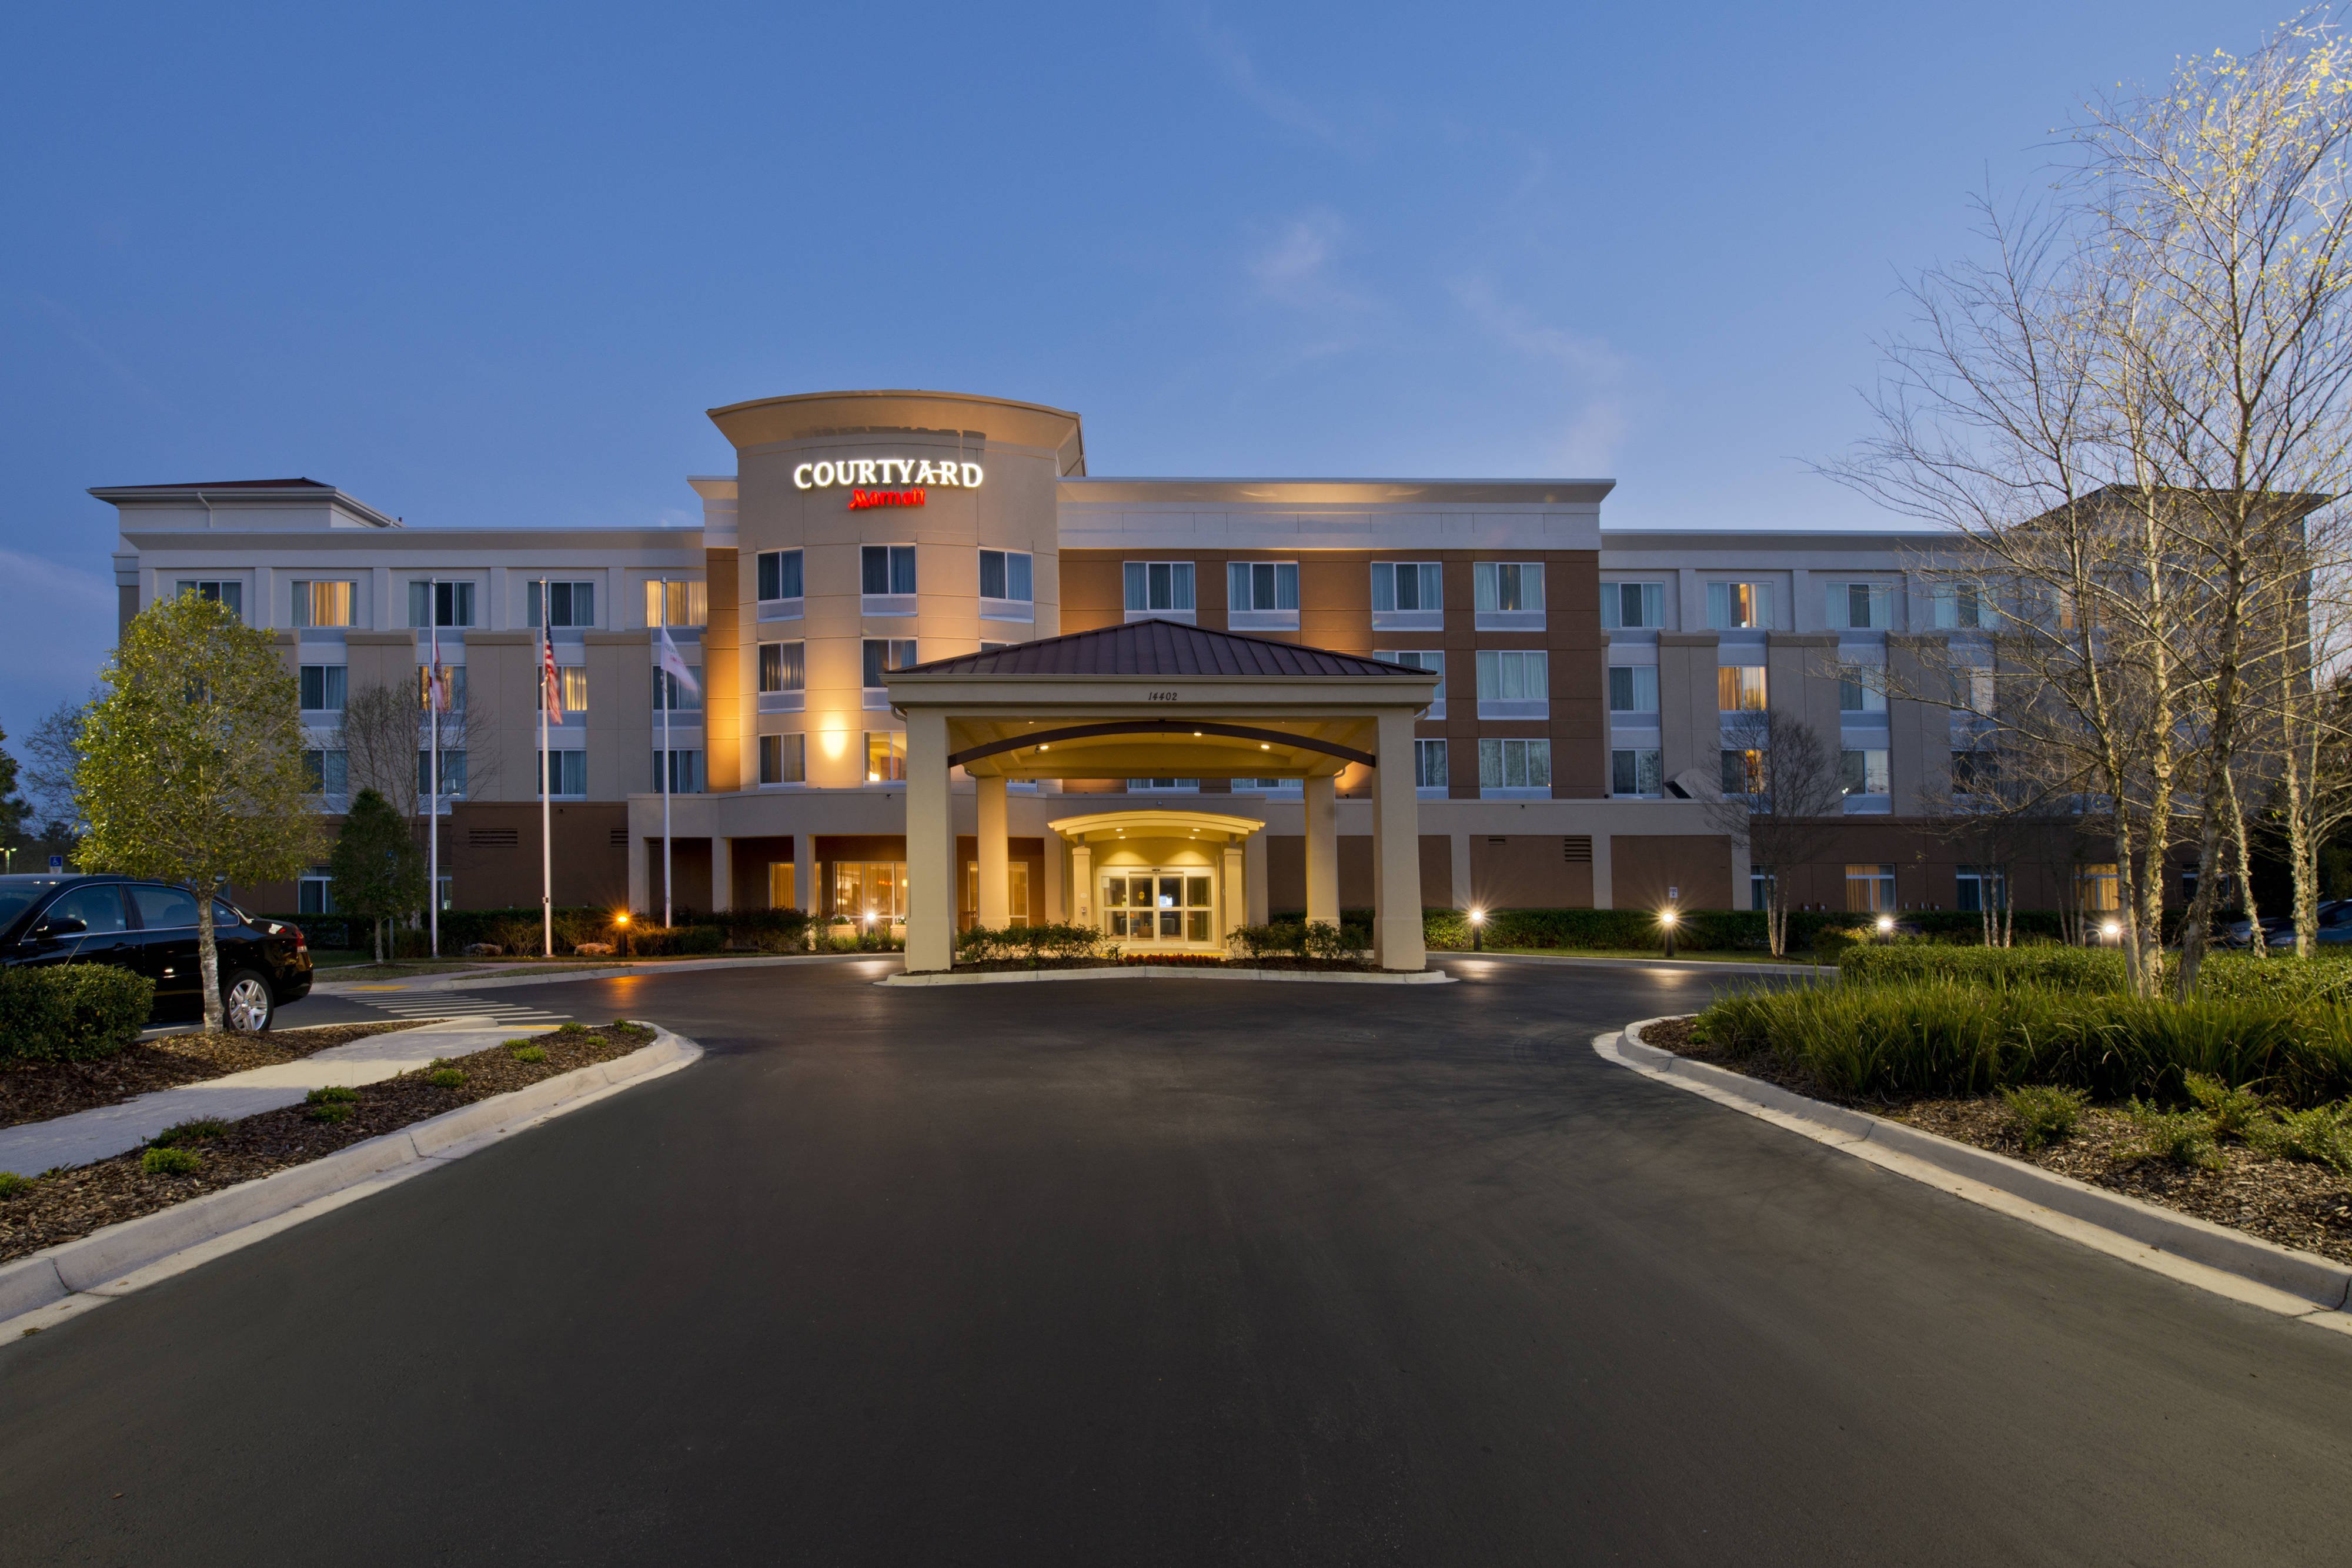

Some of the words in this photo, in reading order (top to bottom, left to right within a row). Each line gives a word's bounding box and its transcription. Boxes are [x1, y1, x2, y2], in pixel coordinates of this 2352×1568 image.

[794, 459, 983, 489] COURTYARD
[848, 488, 925, 509] Marriott
[1148, 692, 1177, 701] 14402
